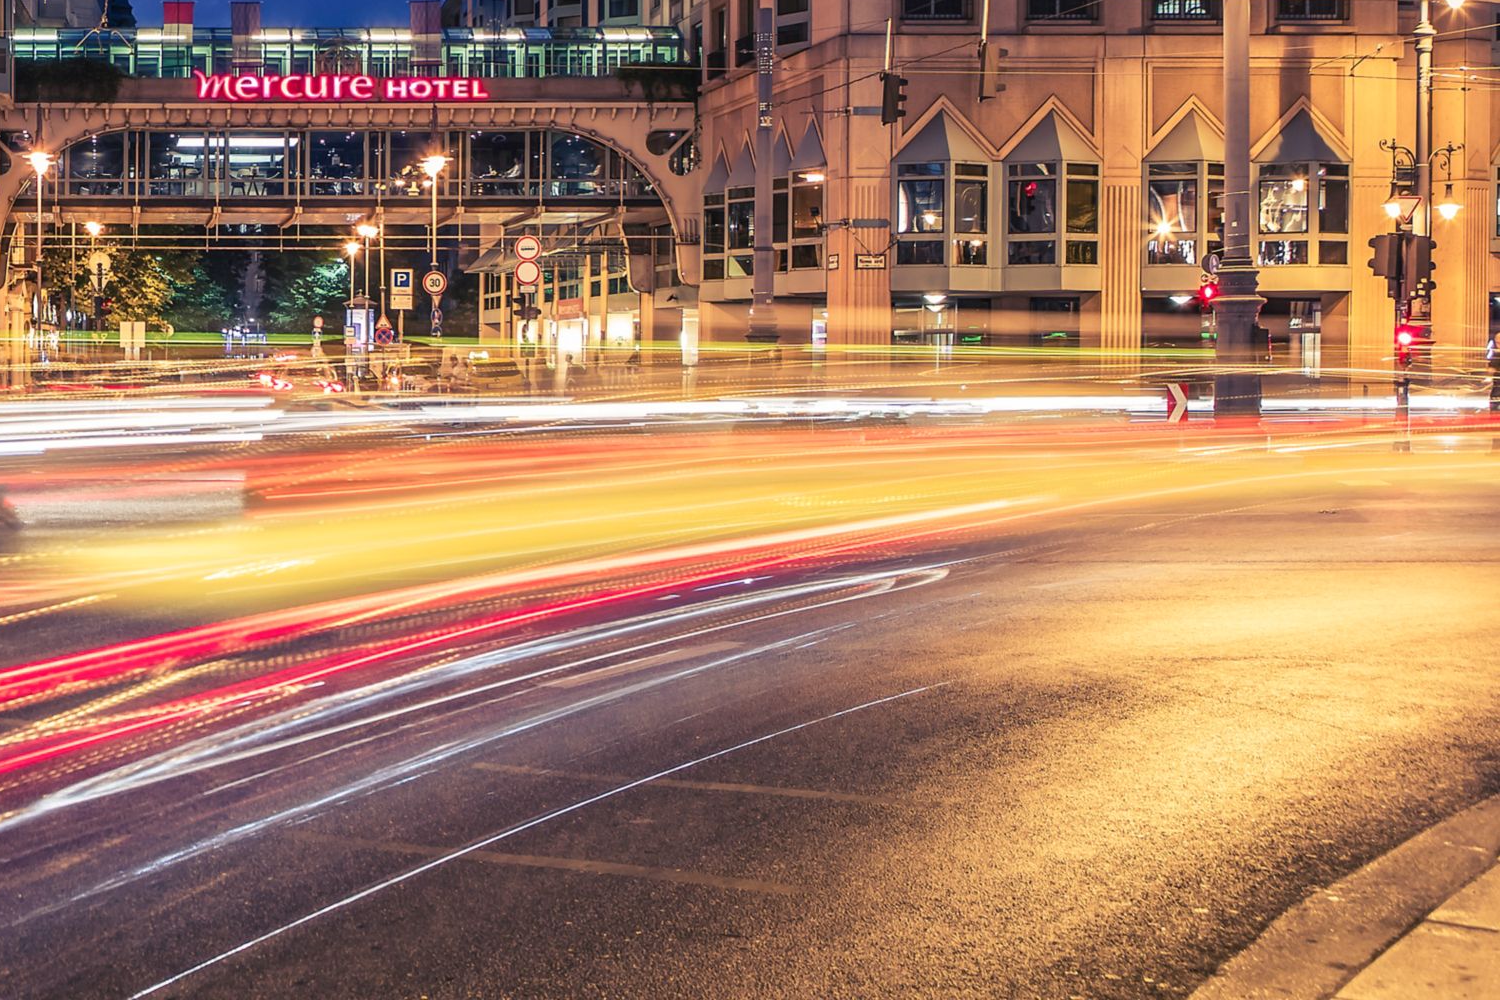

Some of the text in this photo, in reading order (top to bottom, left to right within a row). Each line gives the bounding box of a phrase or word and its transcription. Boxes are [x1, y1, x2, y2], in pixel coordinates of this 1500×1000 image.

[193, 69, 488, 100] mercure HOTEL
[397, 273, 407, 286] P
[429, 278, 440, 287] 30
